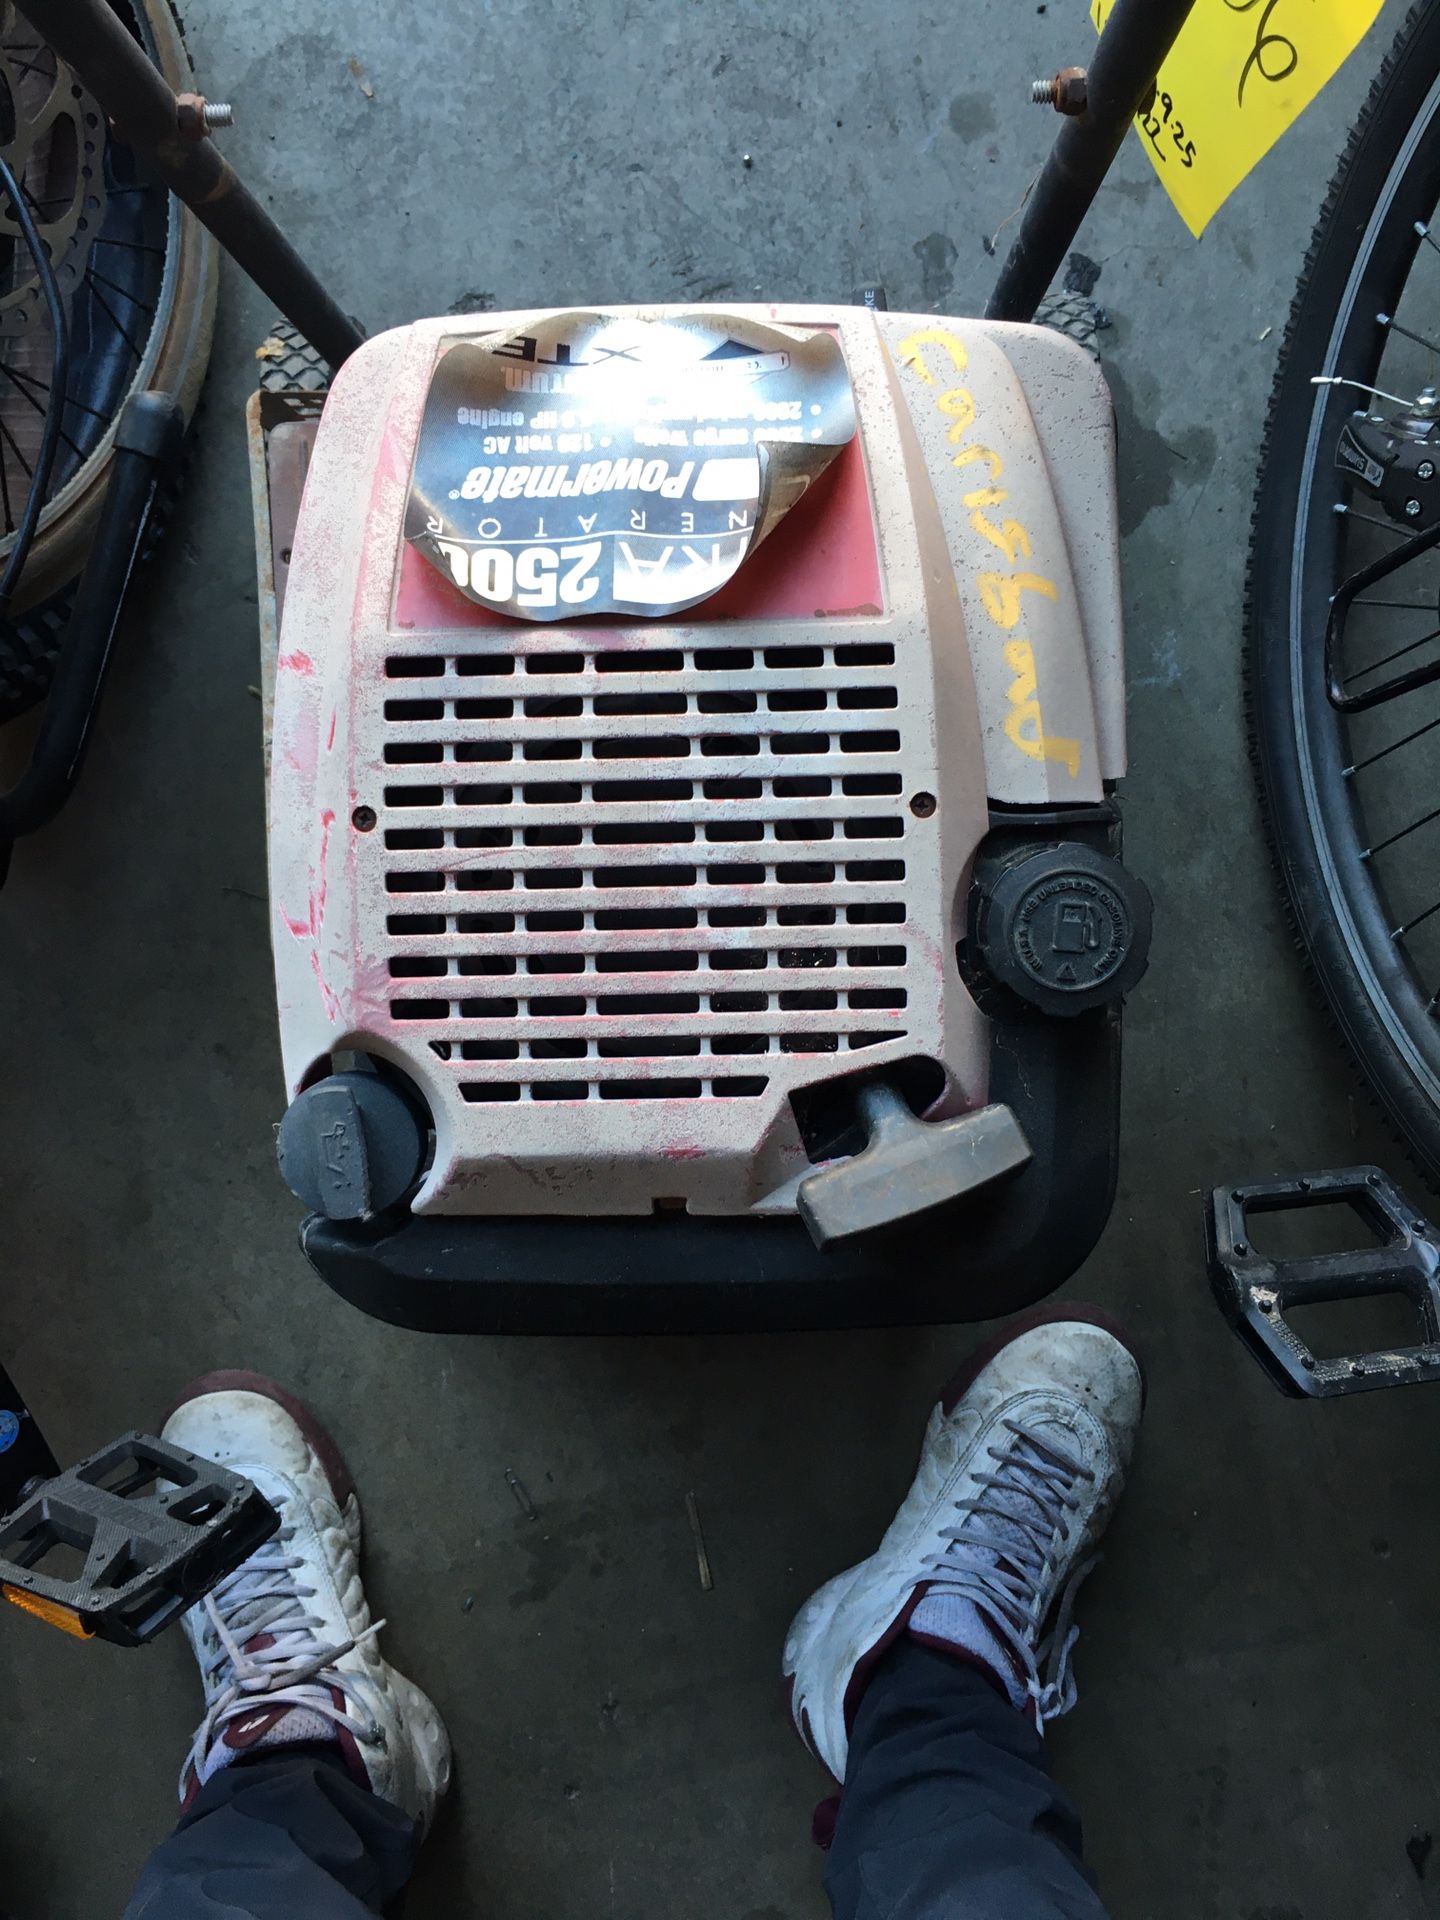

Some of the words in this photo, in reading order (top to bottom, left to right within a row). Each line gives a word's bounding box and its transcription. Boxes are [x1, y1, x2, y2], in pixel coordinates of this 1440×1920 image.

[457, 406, 524, 430] engine
[483, 434, 511, 455] AC
[514, 434, 553, 454] volt
[461, 457, 696, 504] Powermate
